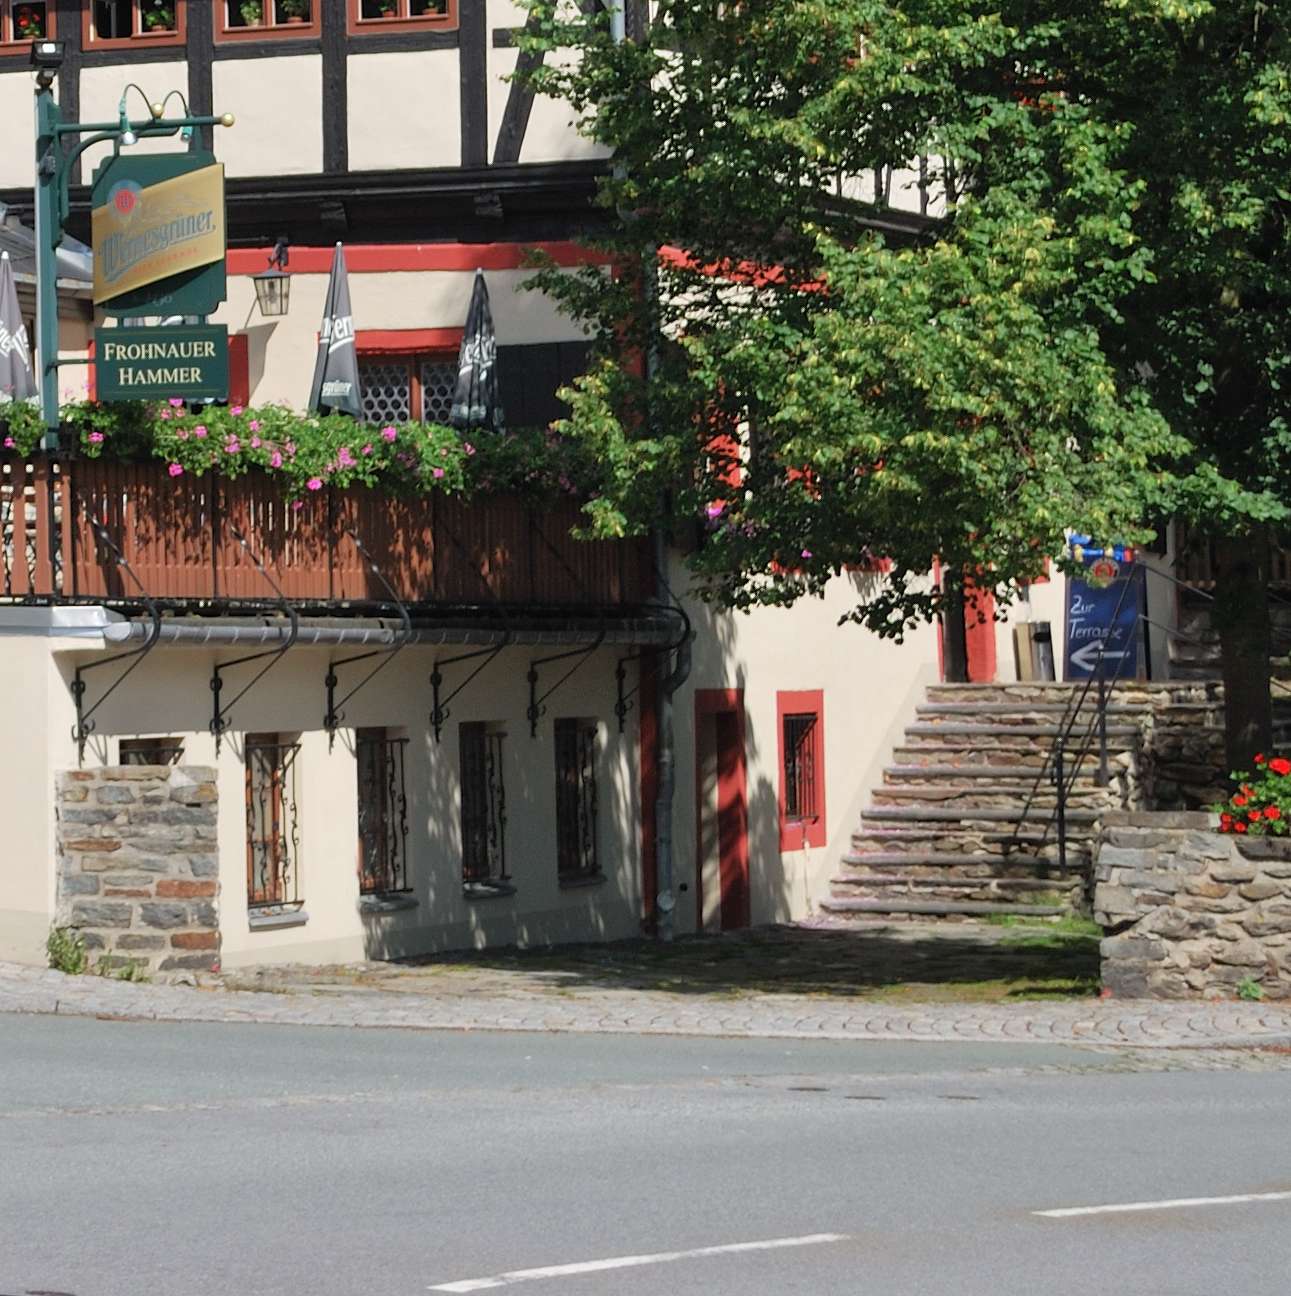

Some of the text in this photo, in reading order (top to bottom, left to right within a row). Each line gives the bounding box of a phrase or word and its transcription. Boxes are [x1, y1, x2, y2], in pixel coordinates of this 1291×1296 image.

[104, 341, 216, 361] FROHNAUER
[118, 367, 203, 385] HAMMER
[1070, 594, 1095, 615] Zur
